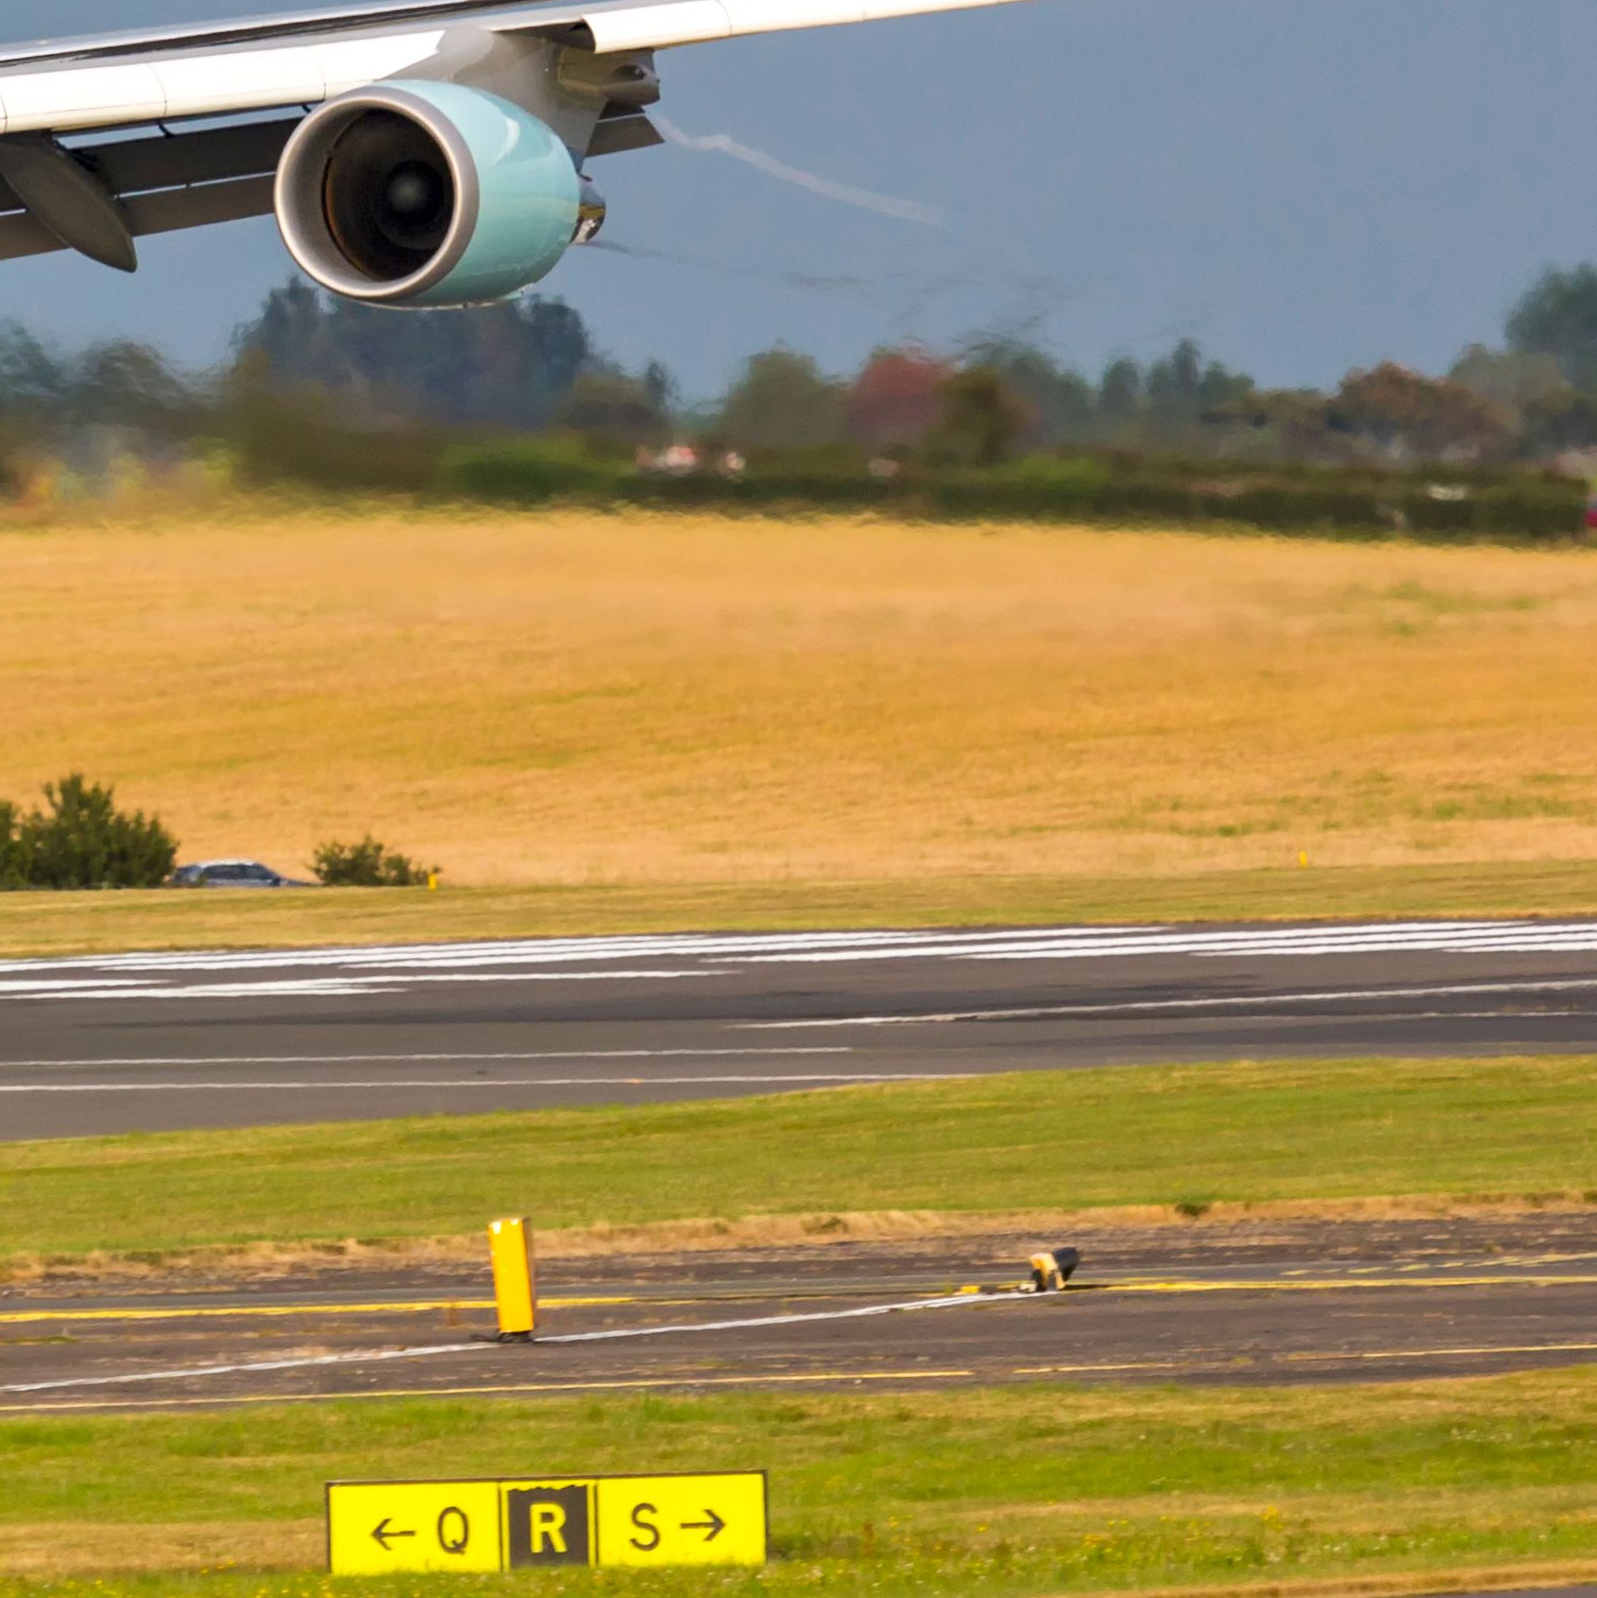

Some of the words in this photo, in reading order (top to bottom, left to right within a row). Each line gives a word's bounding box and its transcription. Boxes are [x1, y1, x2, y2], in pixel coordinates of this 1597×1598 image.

[436, 1506, 470, 1555] Q
[529, 1503, 567, 1554] R
[629, 1503, 660, 1551] S
